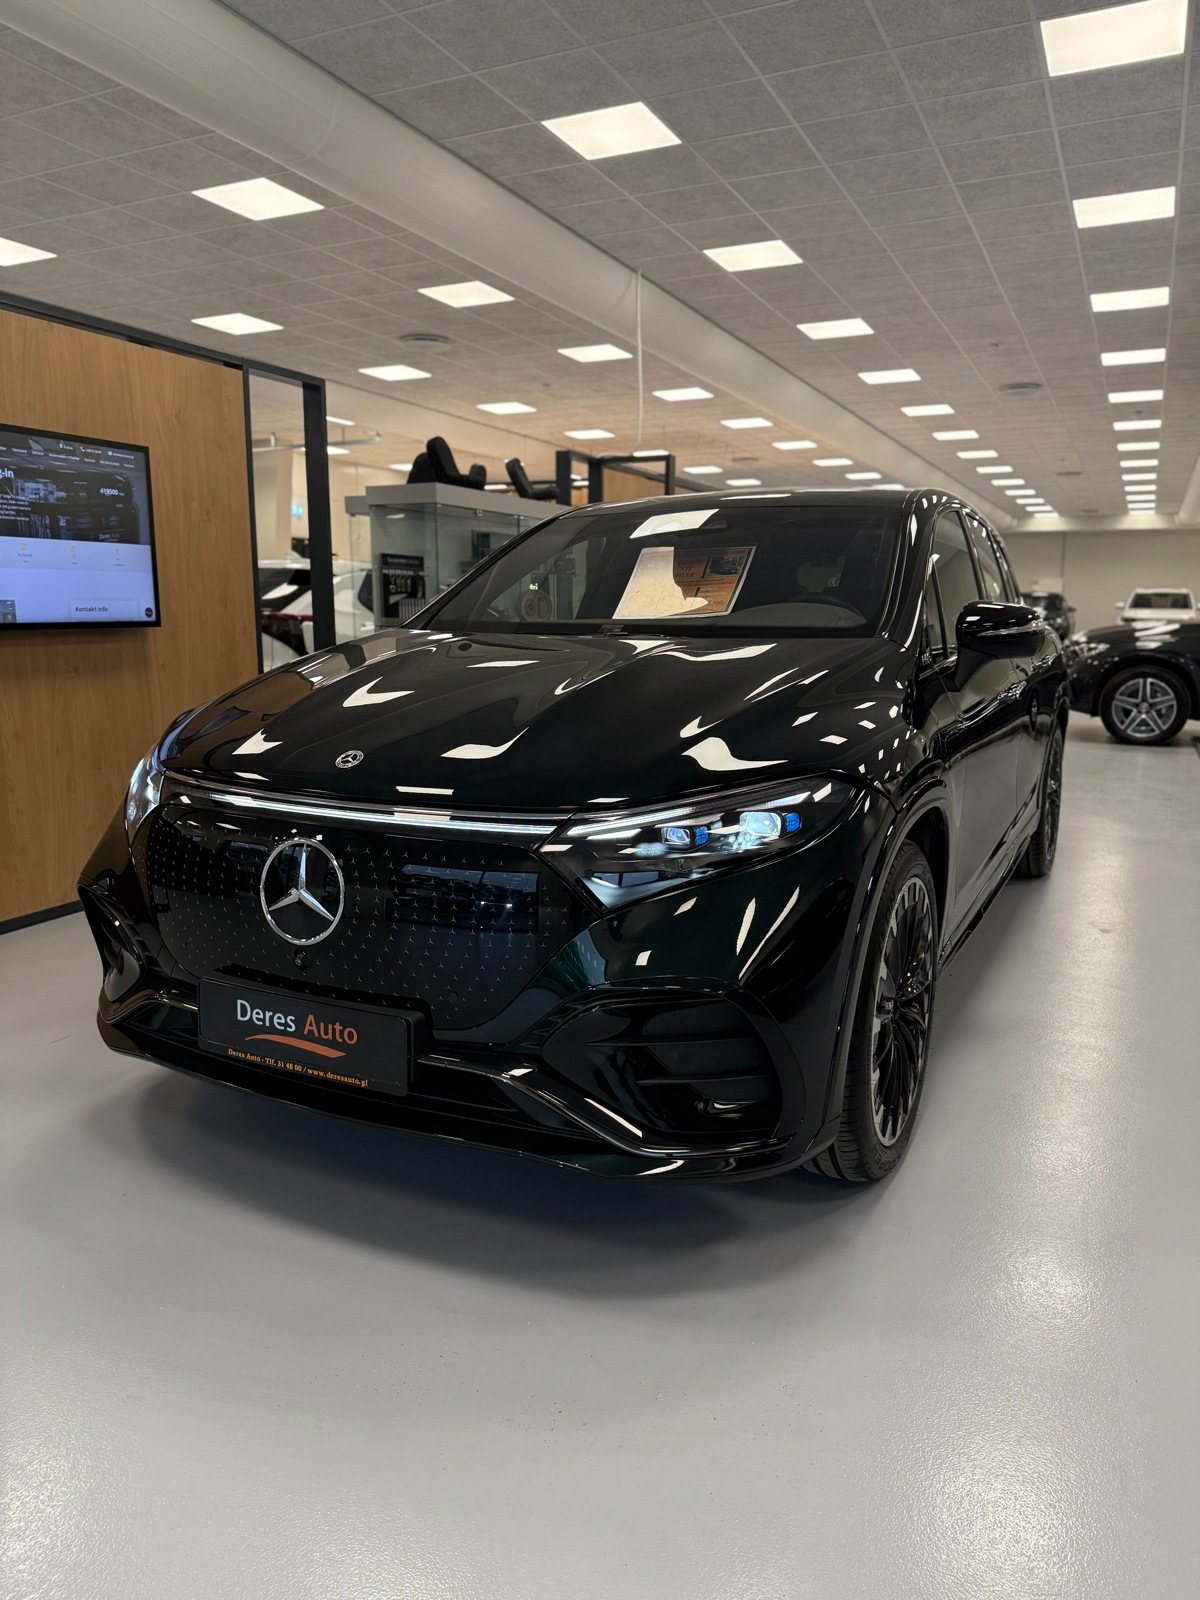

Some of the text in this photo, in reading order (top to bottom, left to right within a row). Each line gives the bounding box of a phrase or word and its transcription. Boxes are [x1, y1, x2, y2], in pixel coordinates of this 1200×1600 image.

[236, 999, 358, 1045] Deres Auto
[228, 1048, 245, 1058] Deres
[246, 1053, 261, 1063] Auto
[277, 1061, 285, 1069] 31
[285, 1062, 294, 1071] 48
[294, 1064, 303, 1073] 00
